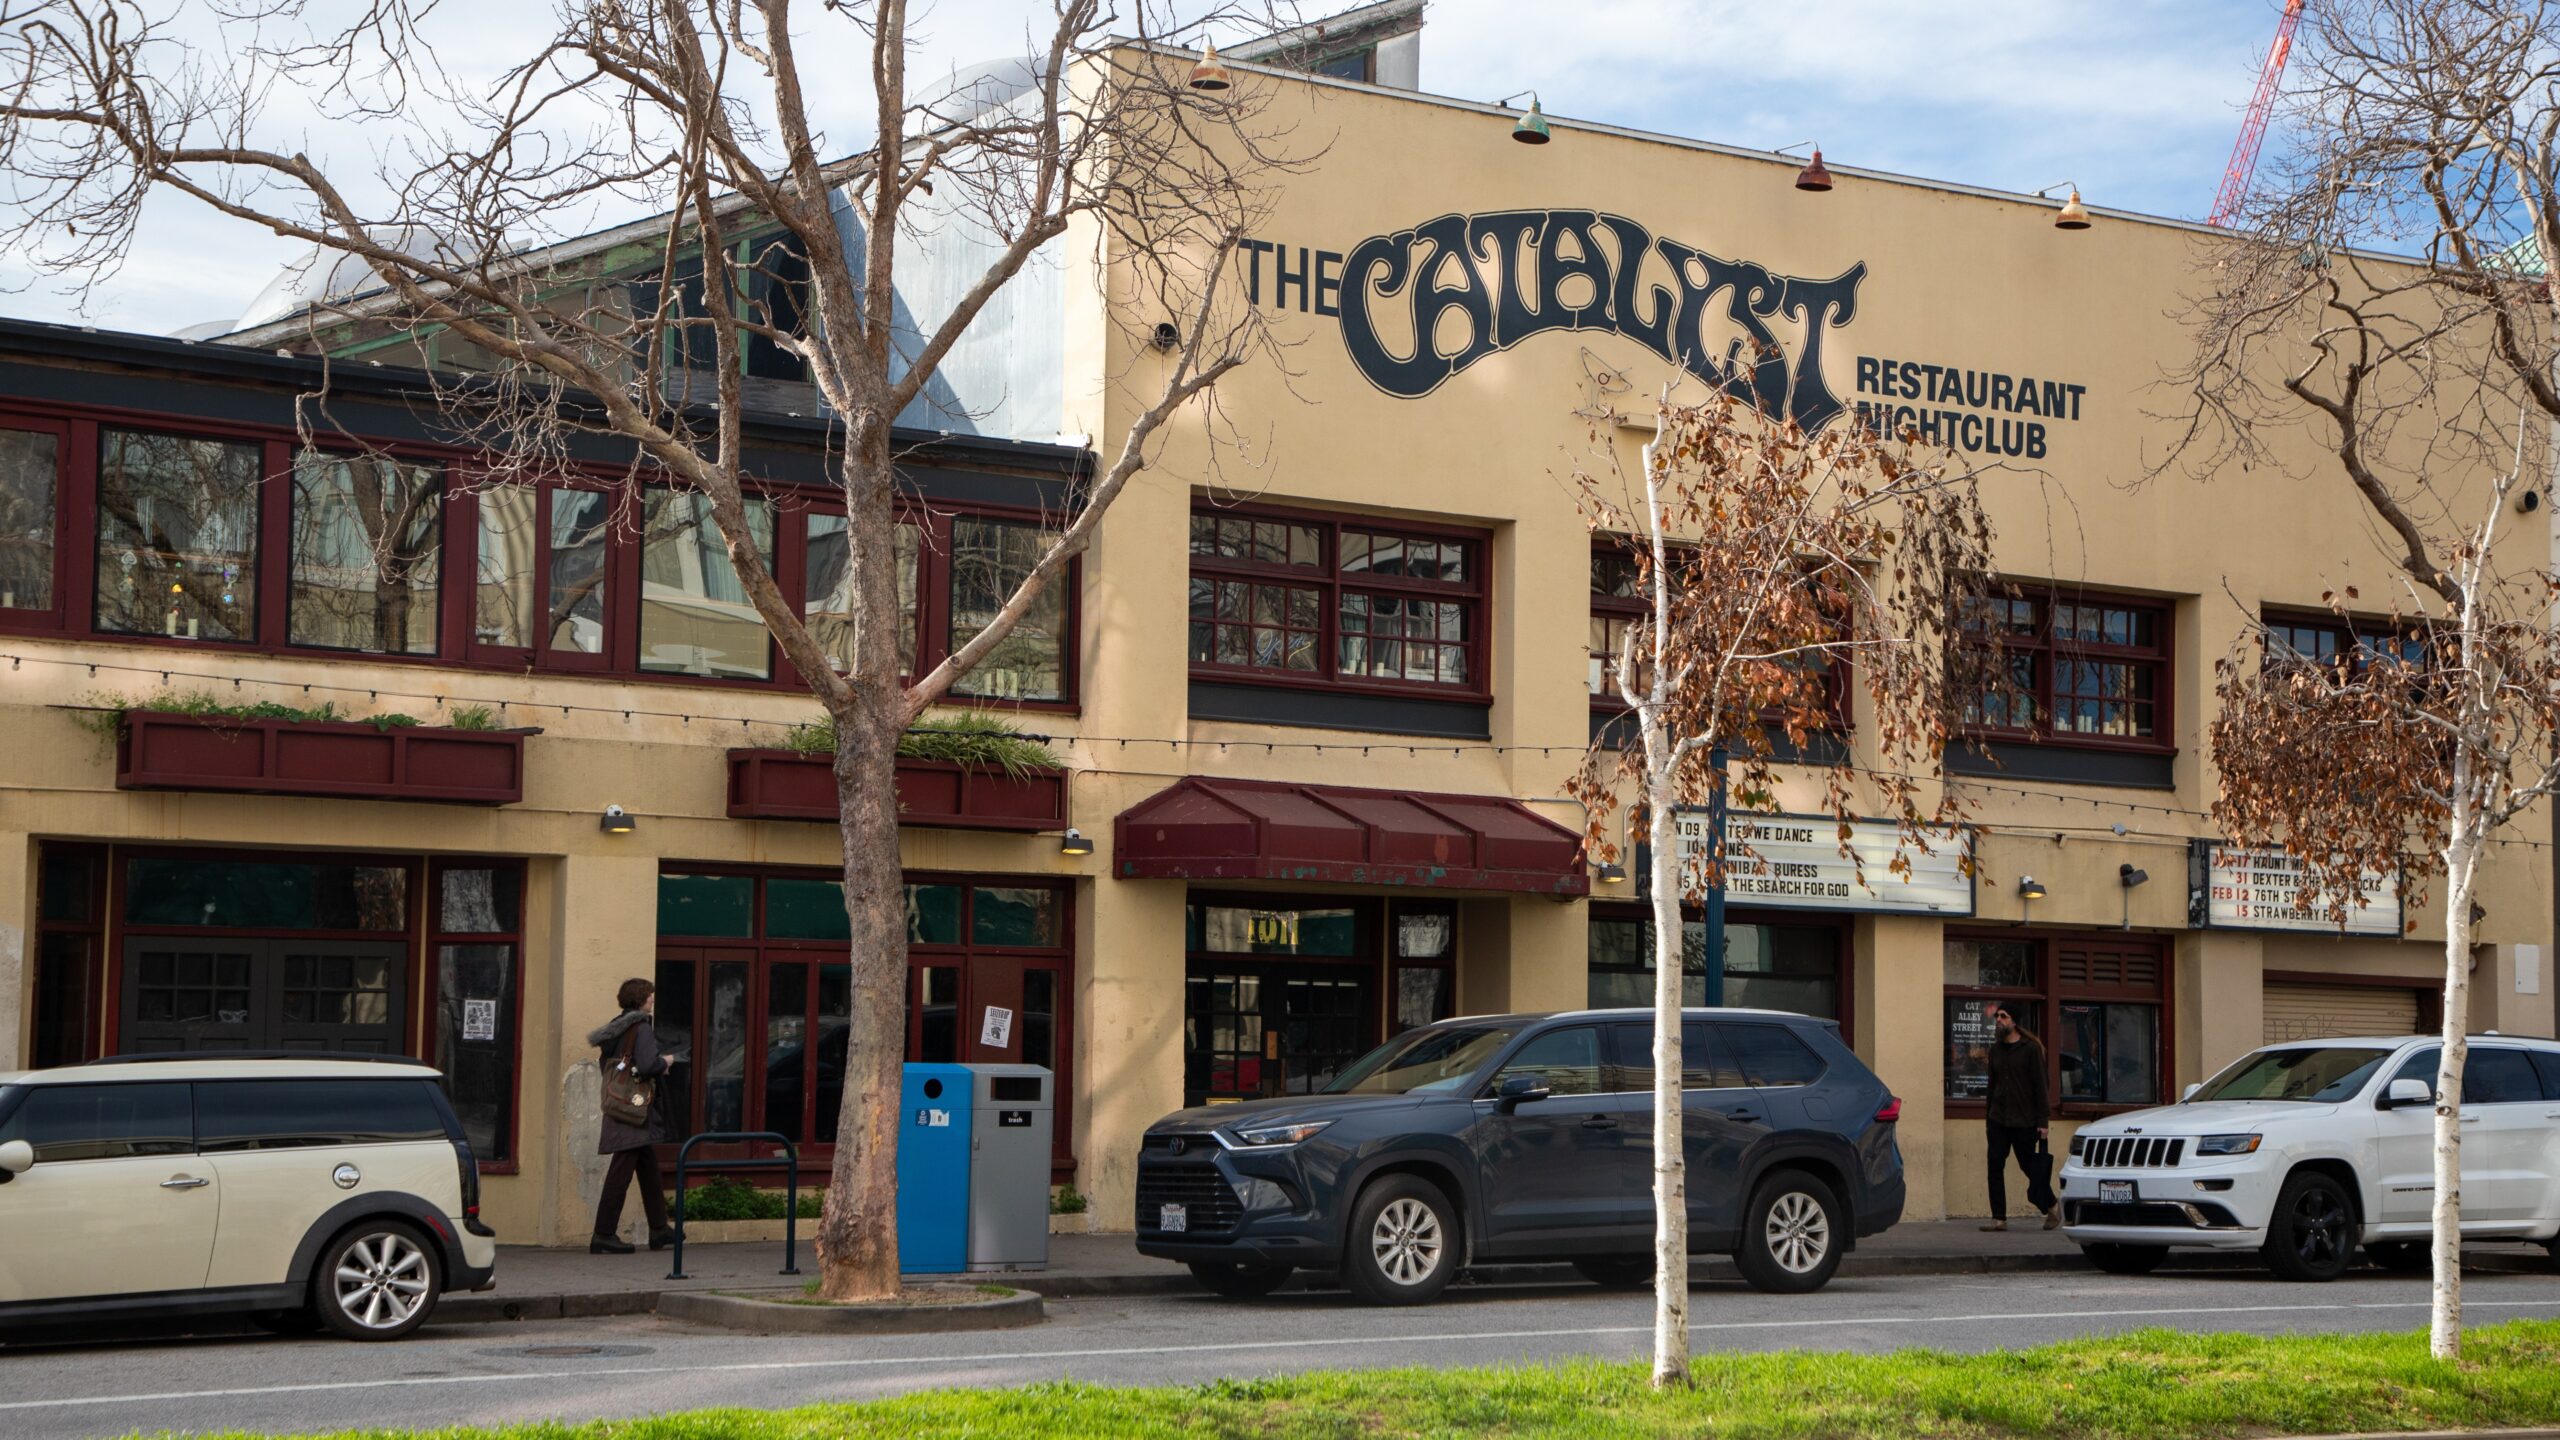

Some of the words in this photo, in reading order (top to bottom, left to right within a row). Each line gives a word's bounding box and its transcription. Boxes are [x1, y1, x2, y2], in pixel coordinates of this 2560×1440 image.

[1238, 238, 1343, 317] THE
[1338, 207, 1867, 444] CATALYST
[1856, 356, 2086, 421] RESTAURANT
[1856, 400, 2047, 460] NIGHTCLUB
[1685, 822, 1700, 836] 09
[1754, 826, 1770, 840] WE
[1775, 827, 1813, 843] DANCE
[1774, 863, 1818, 878] BURESS
[2253, 856, 2286, 870] HAUNT
[2236, 871, 2248, 884] 31
[2253, 873, 2291, 887] DEXTER
[2293, 875, 2299, 887] &
[1732, 878, 1754, 892] THE
[1757, 879, 1801, 895] SEARCH
[1804, 882, 1825, 896] FOR
[1827, 883, 1849, 897] GOD
[2212, 886, 2233, 900] FEB
[2236, 888, 2249, 901] 12
[2255, 889, 2279, 903] 76TH
[2236, 904, 2248, 918] 15
[2253, 905, 2320, 920] STRAWBERRY
[1965, 1001, 1981, 1011] CAT
[1958, 1012, 1982, 1021] ALLEY
[1952, 1022, 1982, 1032] STREET
[2123, 1126, 2143, 1135] Jeep
